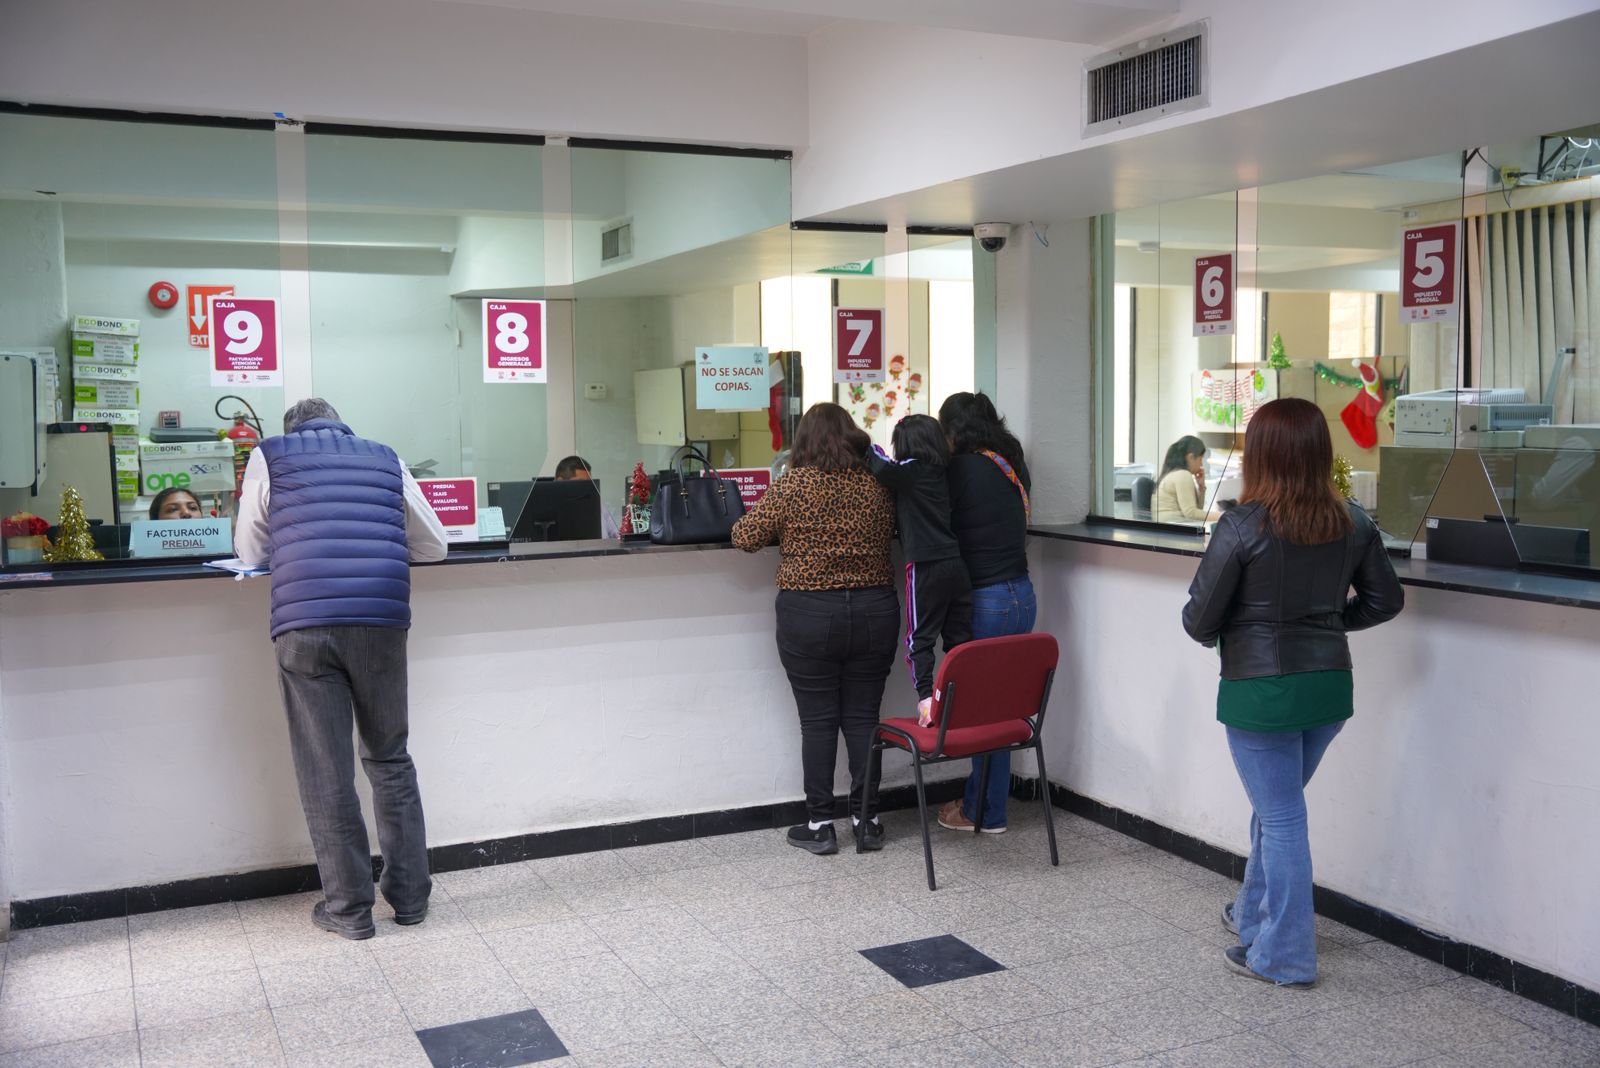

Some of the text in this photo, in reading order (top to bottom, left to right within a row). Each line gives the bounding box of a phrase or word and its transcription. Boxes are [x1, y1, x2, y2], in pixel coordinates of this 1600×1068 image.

[1412, 239, 1445, 288] 5
[1201, 266, 1224, 307] 6
[1414, 290, 1442, 299] IMPUESTO
[78, 318, 122, 328] ECOBOND
[223, 310, 263, 355] 9
[494, 312, 530, 354] 8
[846, 319, 873, 356] 7
[78, 365, 122, 374] ECOBOND
[701, 367, 764, 377] NO SE SACAN
[714, 382, 752, 391] COPIAS.
[77, 410, 121, 419] ECOBOND
[146, 472, 191, 491] one
[147, 526, 219, 538] FACTURACIÓN
[162, 540, 205, 549] PREDIAL
